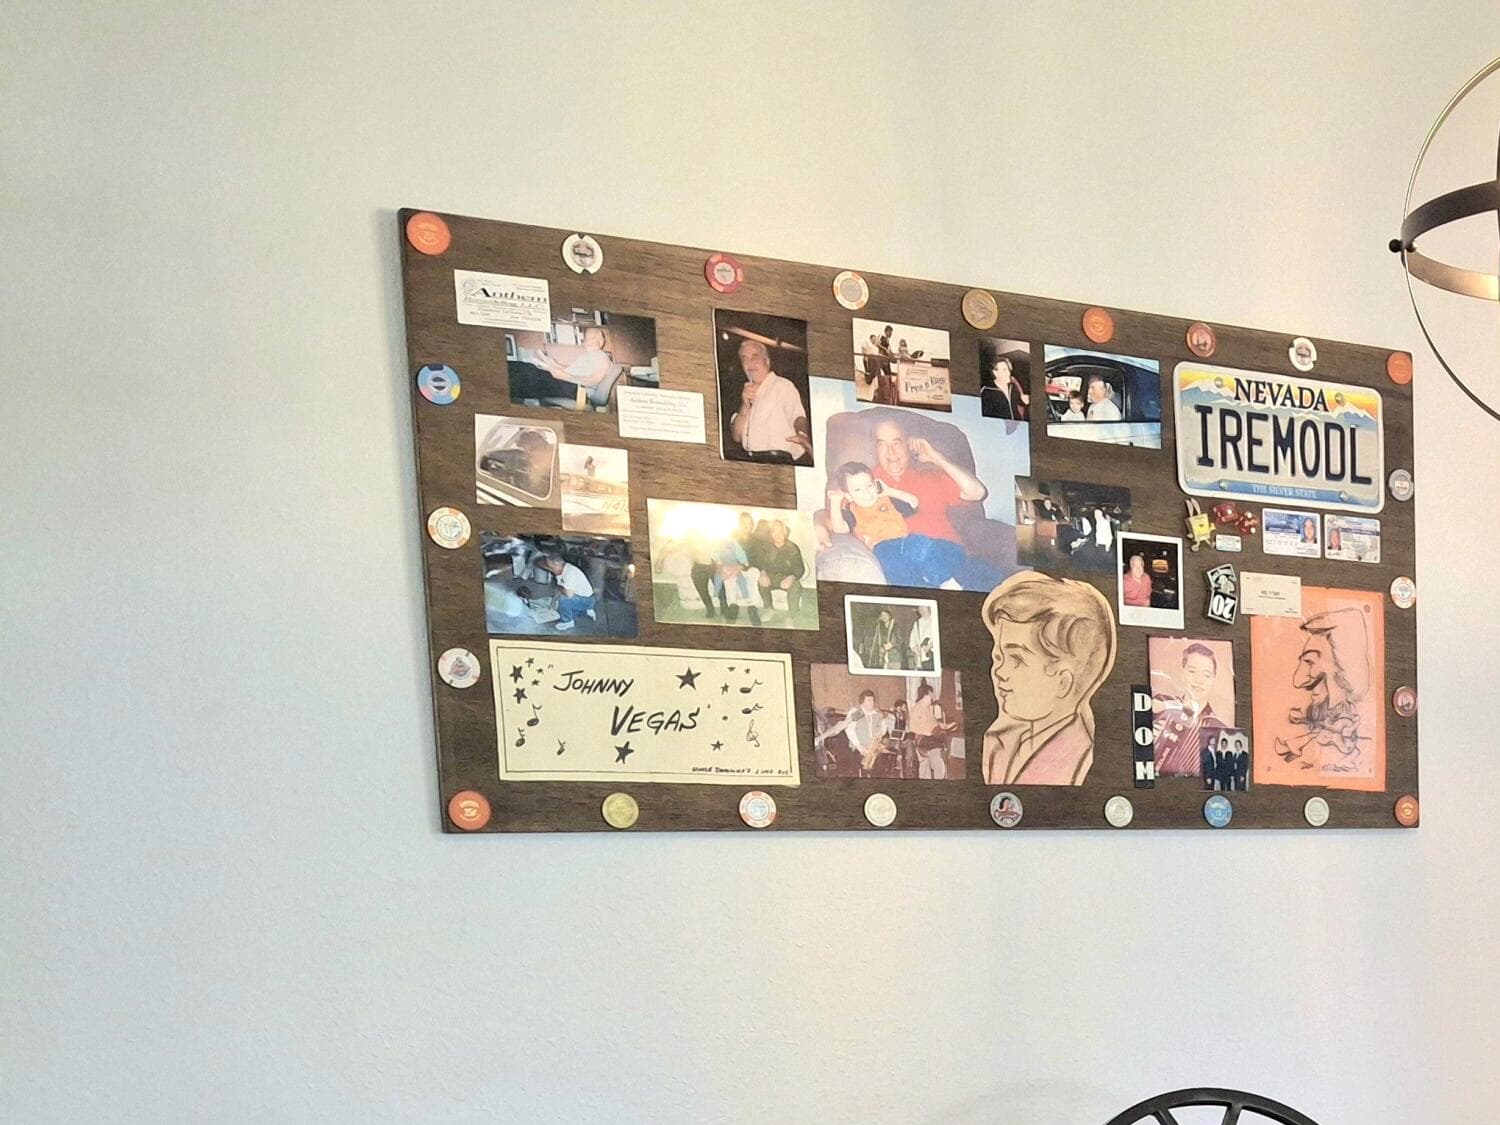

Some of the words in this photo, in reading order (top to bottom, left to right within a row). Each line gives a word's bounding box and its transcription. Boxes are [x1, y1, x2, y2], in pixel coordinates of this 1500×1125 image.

[470, 287, 547, 304] Anthem
[1233, 377, 1330, 412] NEVADA
[1193, 404, 1373, 485] IREMODL
[1253, 486, 1268, 495] THE
[1269, 487, 1294, 497] SILVER
[1295, 489, 1317, 499] STATE
[1133, 692, 1155, 780] DOM
